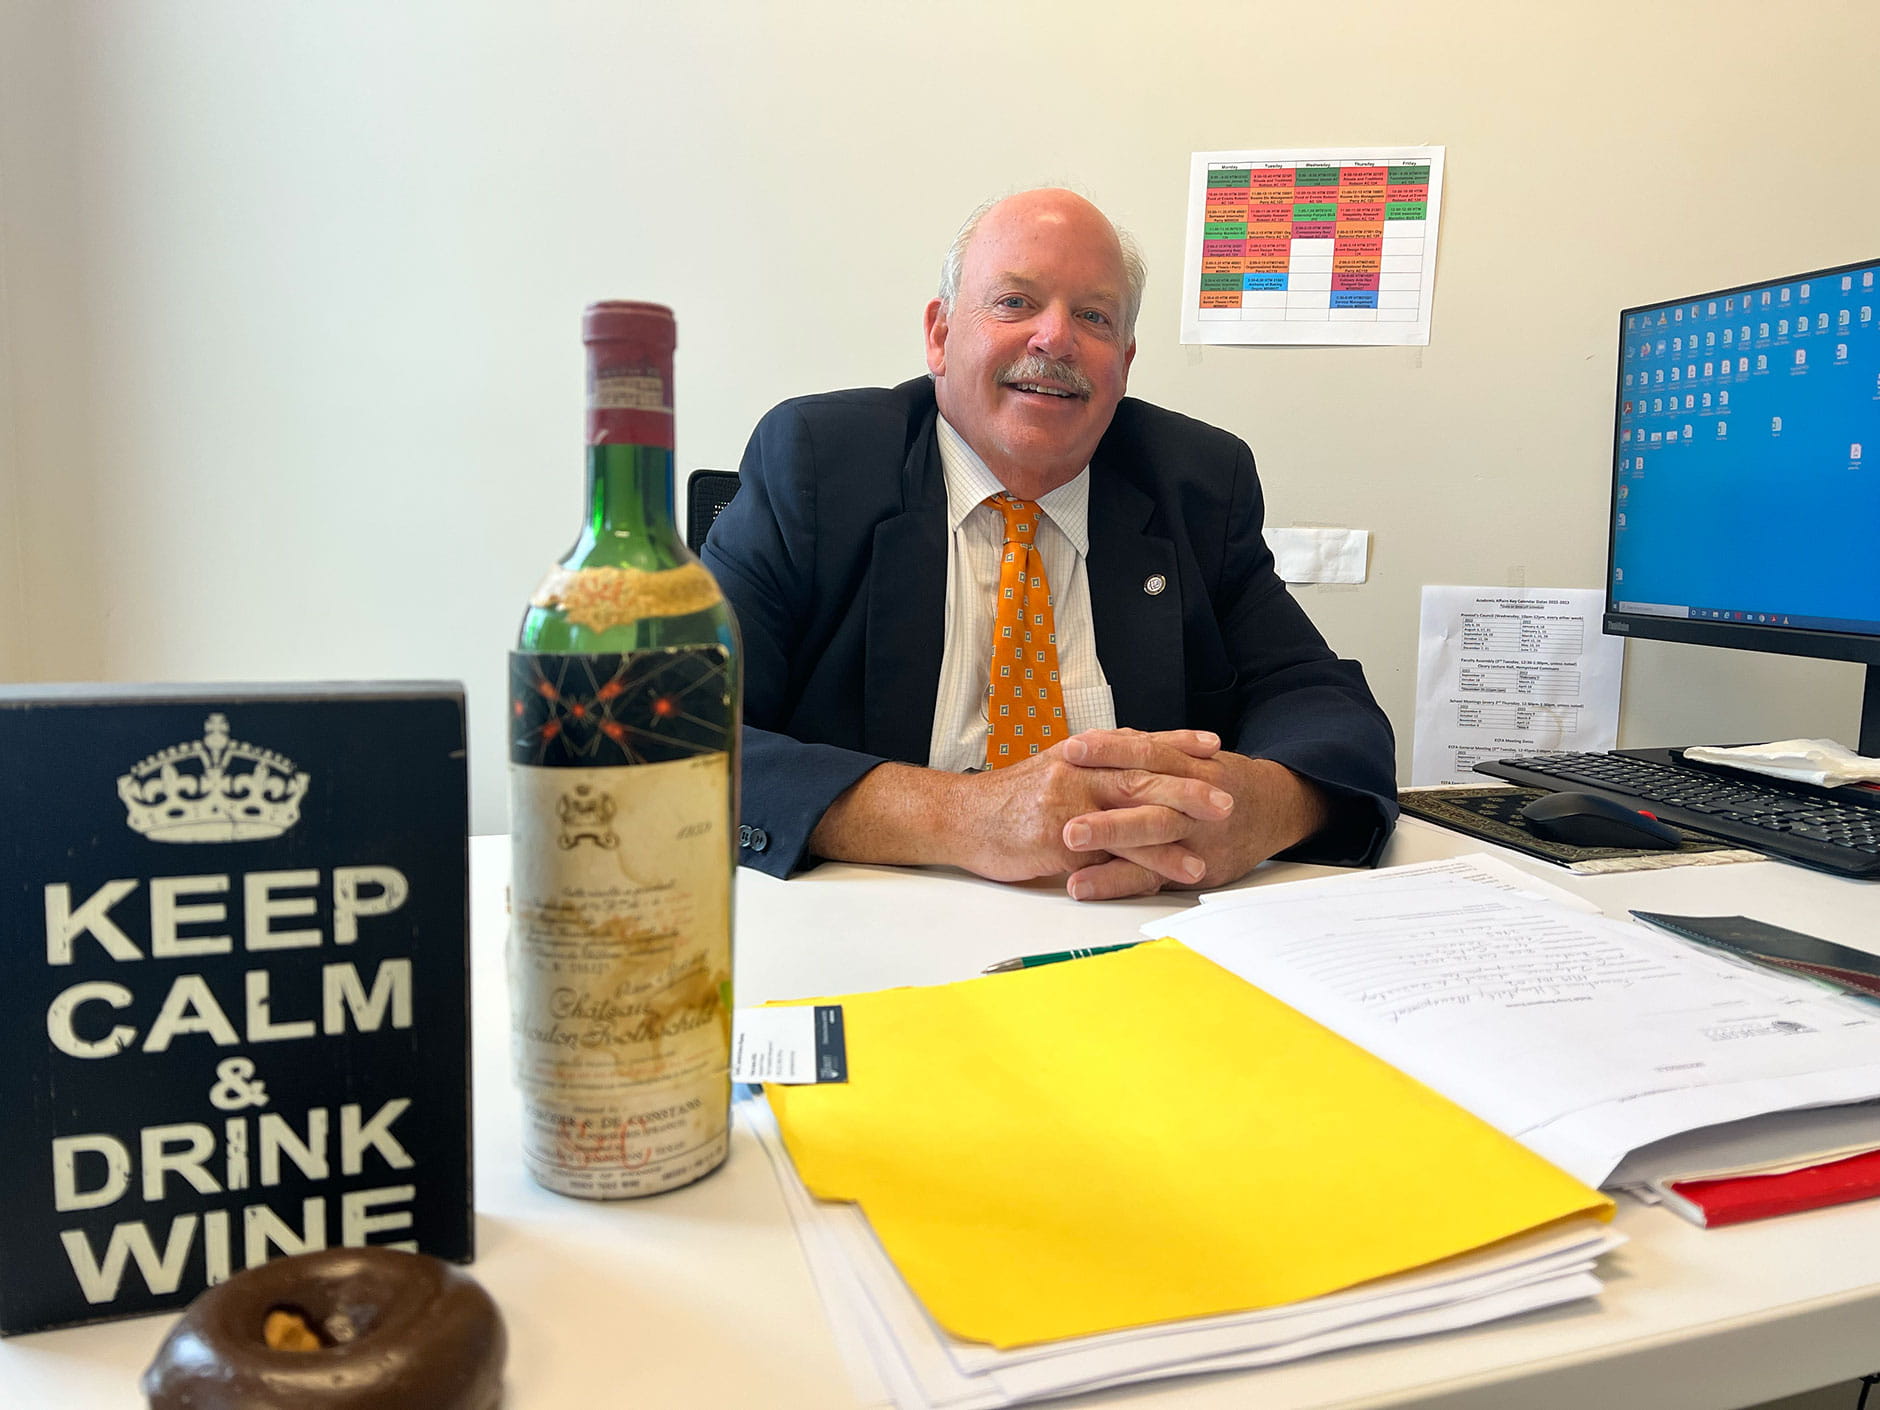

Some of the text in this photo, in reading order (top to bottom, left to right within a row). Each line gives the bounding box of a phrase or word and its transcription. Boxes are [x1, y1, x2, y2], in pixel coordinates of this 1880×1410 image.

[1264, 163, 1283, 171] Tuesday
[1402, 160, 1417, 168] Friday
[44, 865, 409, 966] KEEP
[46, 958, 413, 1060] CALM
[209, 1056, 270, 1111] &
[52, 1098, 416, 1213] DRINK
[59, 1184, 418, 1305] WINE
